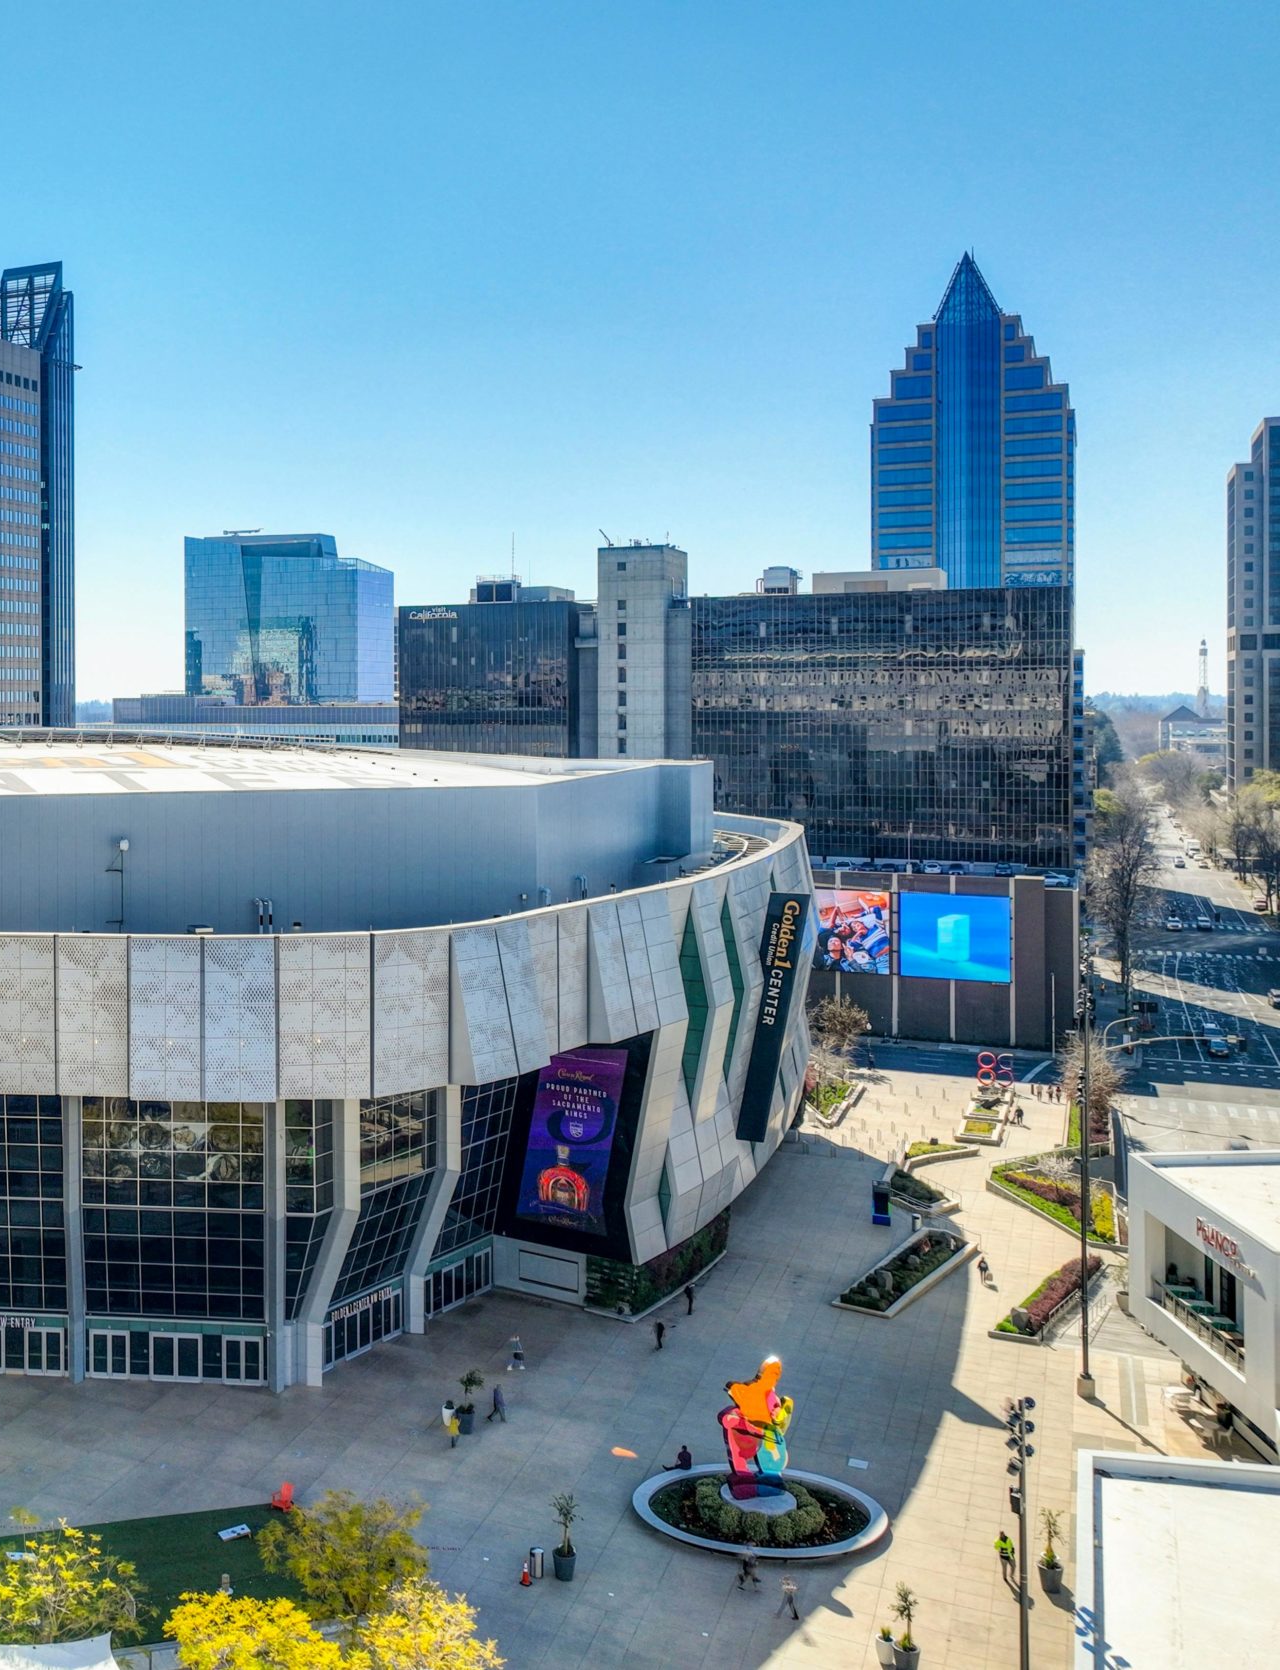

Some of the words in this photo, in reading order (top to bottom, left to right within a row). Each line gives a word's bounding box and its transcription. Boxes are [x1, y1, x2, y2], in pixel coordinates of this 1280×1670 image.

[409, 609, 458, 623] California
[769, 922, 780, 945] Credit
[765, 945, 776, 966] Union
[762, 969, 784, 1026] CENTER
[546, 1082, 570, 1093] PROUD
[573, 1087, 608, 1098] PARTNER
[552, 1100, 601, 1113] SACRAMENTO
[576, 1095, 590, 1104] THE
[565, 1109, 588, 1120] KINGS
[10, 1317, 36, 1329] ENTRY
